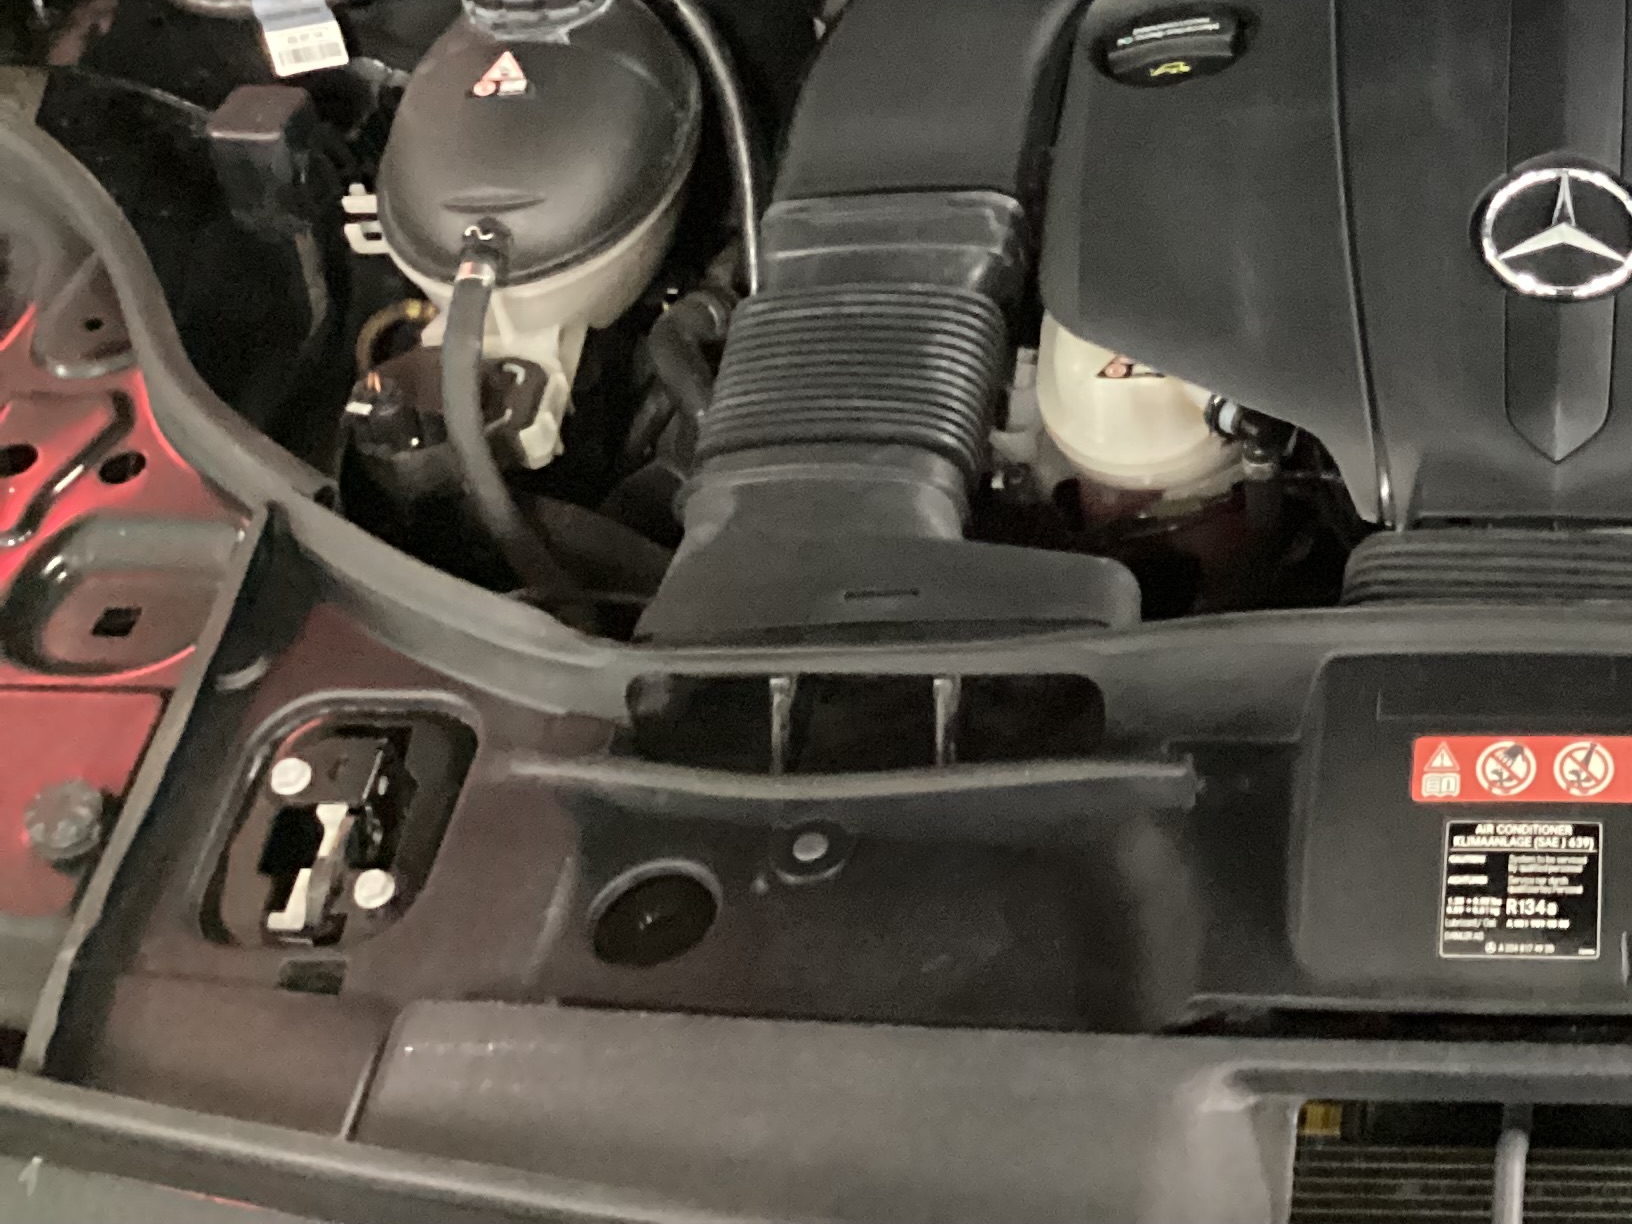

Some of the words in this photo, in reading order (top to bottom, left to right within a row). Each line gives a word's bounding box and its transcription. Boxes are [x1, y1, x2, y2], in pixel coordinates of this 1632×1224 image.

[1475, 823, 1495, 835] AIR
[1496, 823, 1573, 836] CONDITIONER
[1453, 835, 1532, 847] KLIMAANLAGE
[1533, 836, 1560, 850] (SAE
[1568, 836, 1595, 851] 639)
[1505, 898, 1559, 916] R134a
